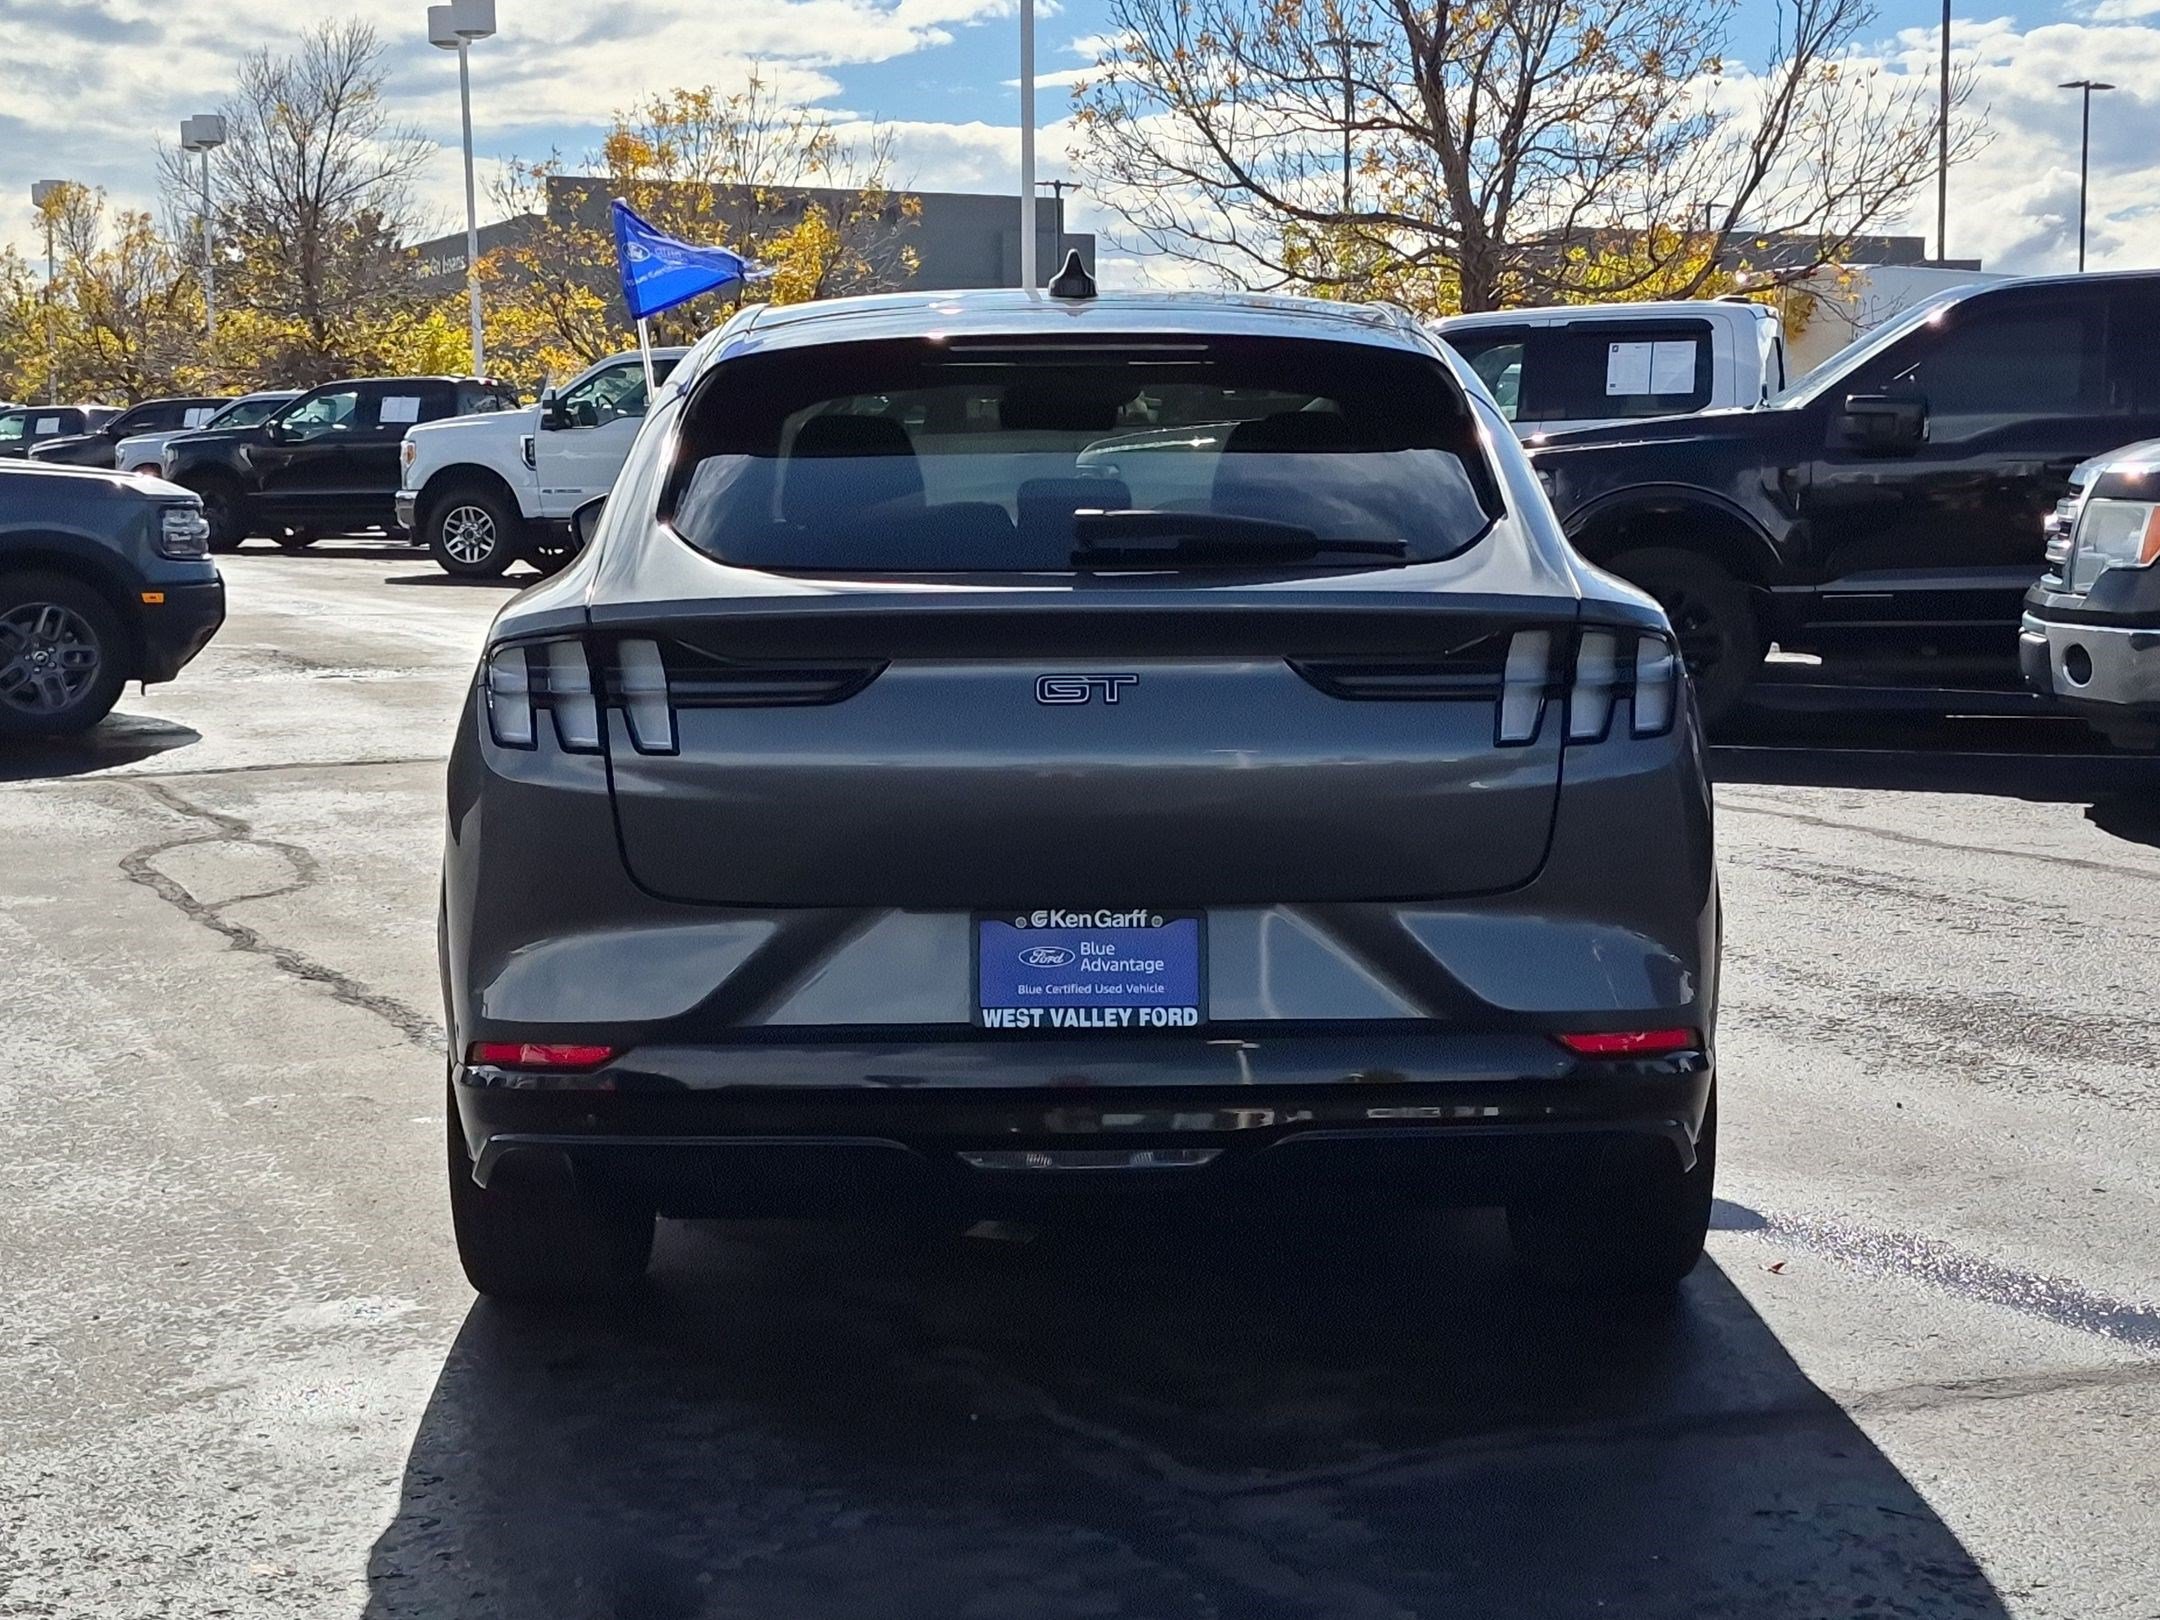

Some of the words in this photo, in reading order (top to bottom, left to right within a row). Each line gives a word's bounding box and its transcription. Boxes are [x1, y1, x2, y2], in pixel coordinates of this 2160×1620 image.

[1035, 673, 1139, 705] GT
[1050, 909, 1091, 928] Ken
[1094, 909, 1148, 928] Garff
[1029, 950, 1065, 964] Ford
[1080, 942, 1116, 956] Blue
[1080, 958, 1165, 974] Advantage
[1018, 984, 1042, 995] Blue
[1045, 984, 1092, 995] Certified
[1095, 984, 1123, 994] Used
[1126, 983, 1165, 994] Vehicle
[982, 1008, 1044, 1028] WEST
[1050, 1008, 1135, 1027] VALLEY
[1139, 1008, 1199, 1027] FORD
